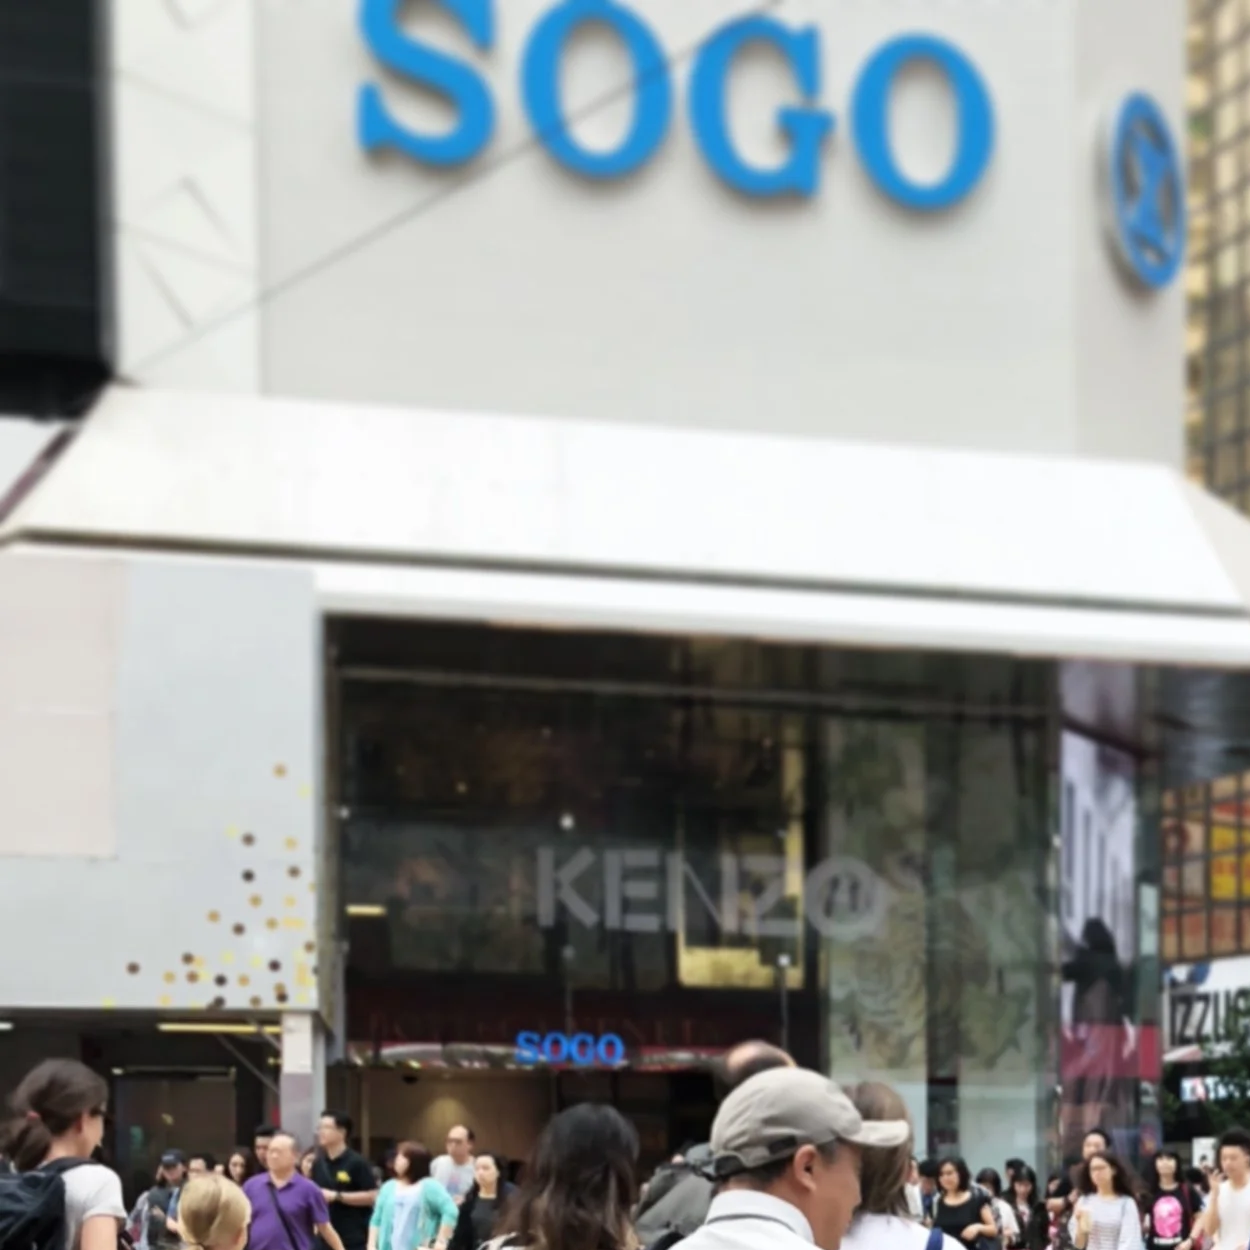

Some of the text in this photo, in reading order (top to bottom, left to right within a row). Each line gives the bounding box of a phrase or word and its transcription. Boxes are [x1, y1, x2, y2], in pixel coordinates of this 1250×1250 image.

[358, 0, 996, 211] SOGO
[537, 846, 889, 940] KENZO
[515, 1030, 625, 1065] SOGO
